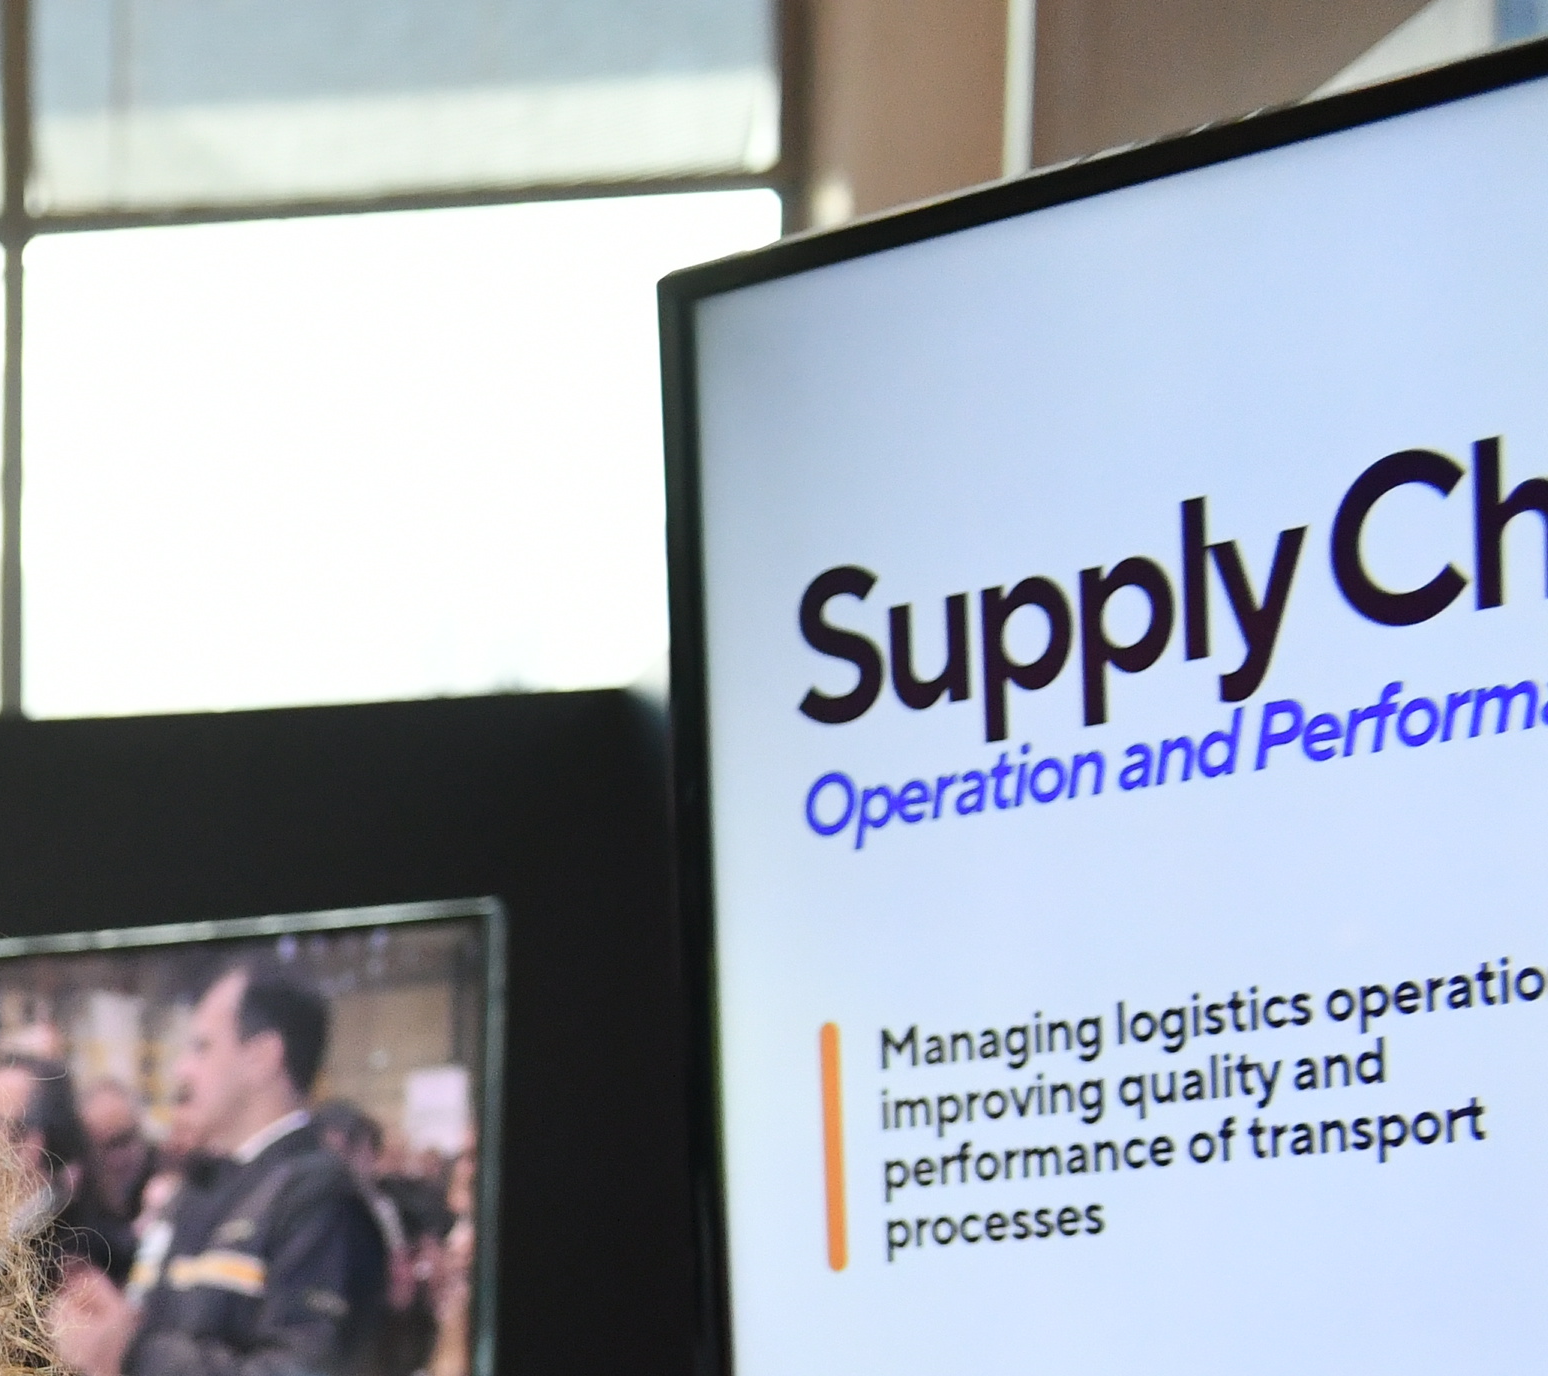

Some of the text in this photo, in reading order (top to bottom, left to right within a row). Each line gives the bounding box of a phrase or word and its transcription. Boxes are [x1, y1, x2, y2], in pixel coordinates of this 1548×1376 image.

[797, 436, 1548, 743] Supply Ch
[805, 680, 1548, 850] Operation and Perform
[880, 956, 1548, 1071] Managing logistics operatio
[881, 1036, 1386, 1137] improving quality and
[884, 1096, 1487, 1202] performance of transport
[886, 1203, 1105, 1262] processes
